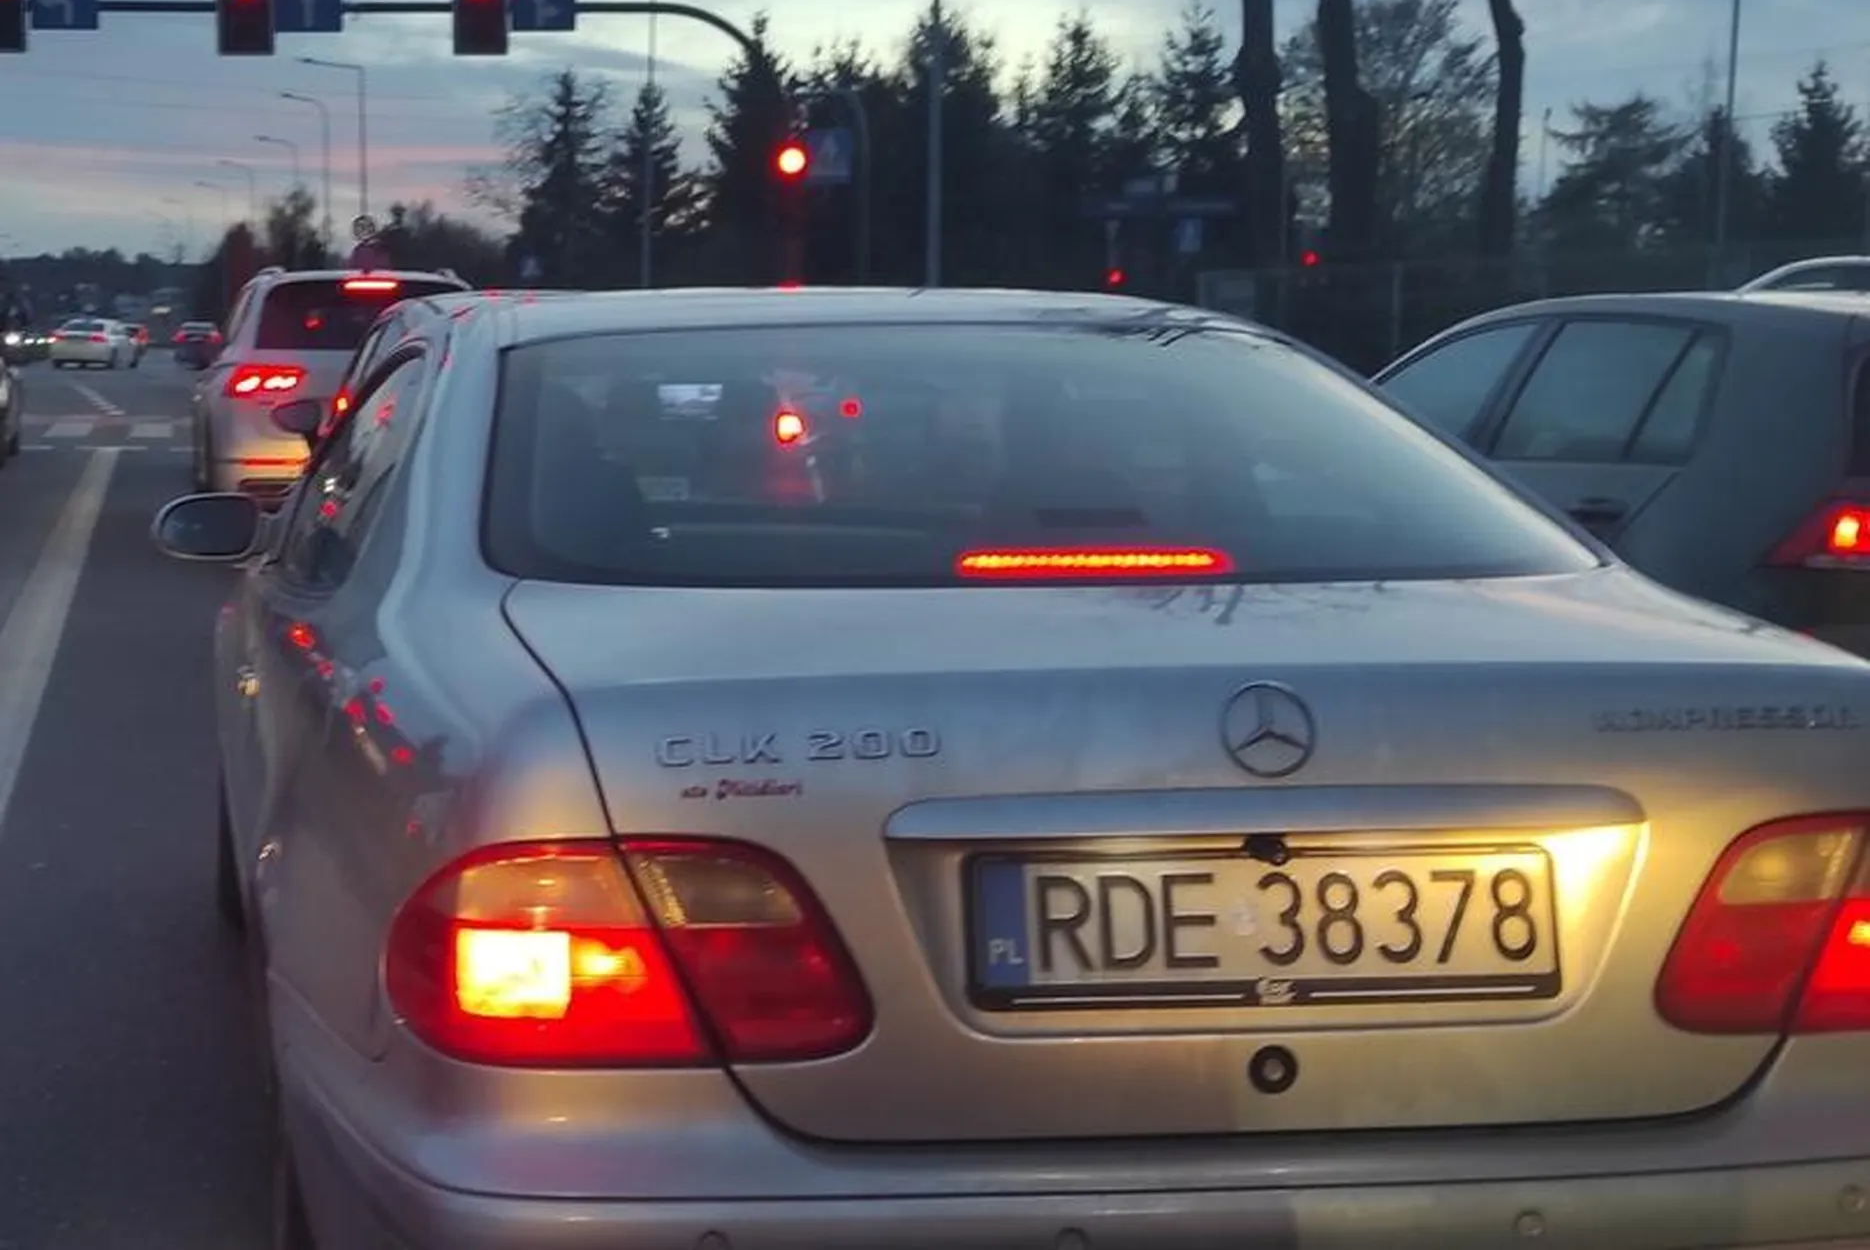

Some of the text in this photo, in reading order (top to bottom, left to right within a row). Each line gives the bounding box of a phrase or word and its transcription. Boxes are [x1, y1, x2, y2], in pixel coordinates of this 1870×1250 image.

[656, 727, 943, 768] CLK 200
[1034, 867, 1538, 972] RDE 38378
[988, 939, 1024, 965] PL
